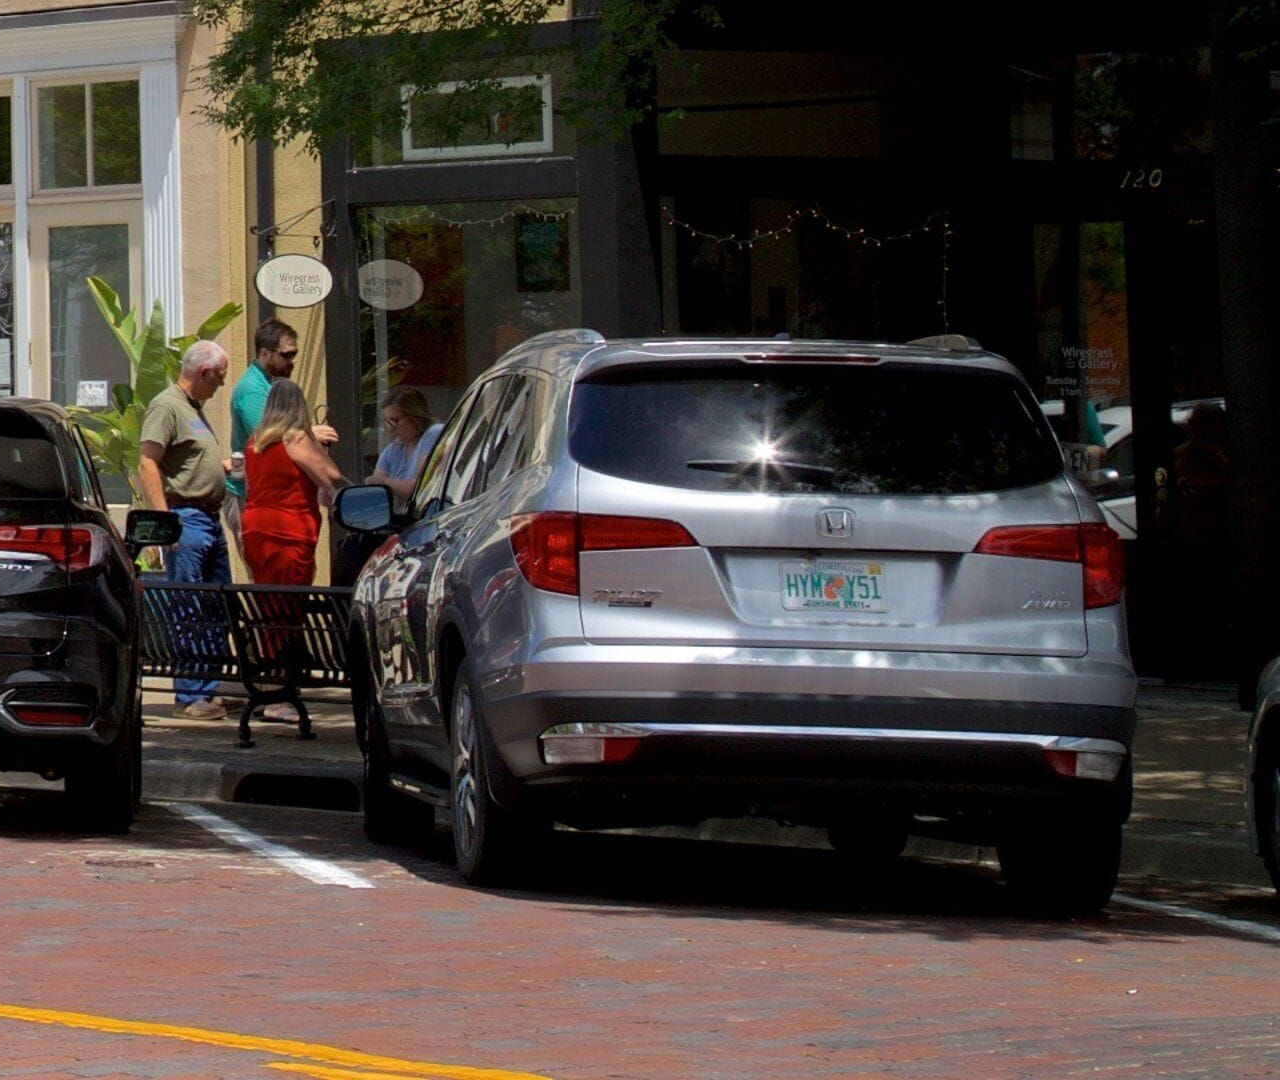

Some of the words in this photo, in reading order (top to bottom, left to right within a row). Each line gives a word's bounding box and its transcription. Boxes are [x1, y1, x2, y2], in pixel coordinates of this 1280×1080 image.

[1120, 168, 1162, 188] 120
[279, 273, 321, 284] Wiregrass
[292, 284, 323, 297] Gallery
[1061, 346, 1115, 360] Wiregrass
[1078, 359, 1119, 371] Gallery
[1045, 376, 1078, 386] Tuesday
[786, 573, 823, 598] HYM
[845, 575, 882, 600] Y51
[806, 599, 840, 608] SUNSHINE
